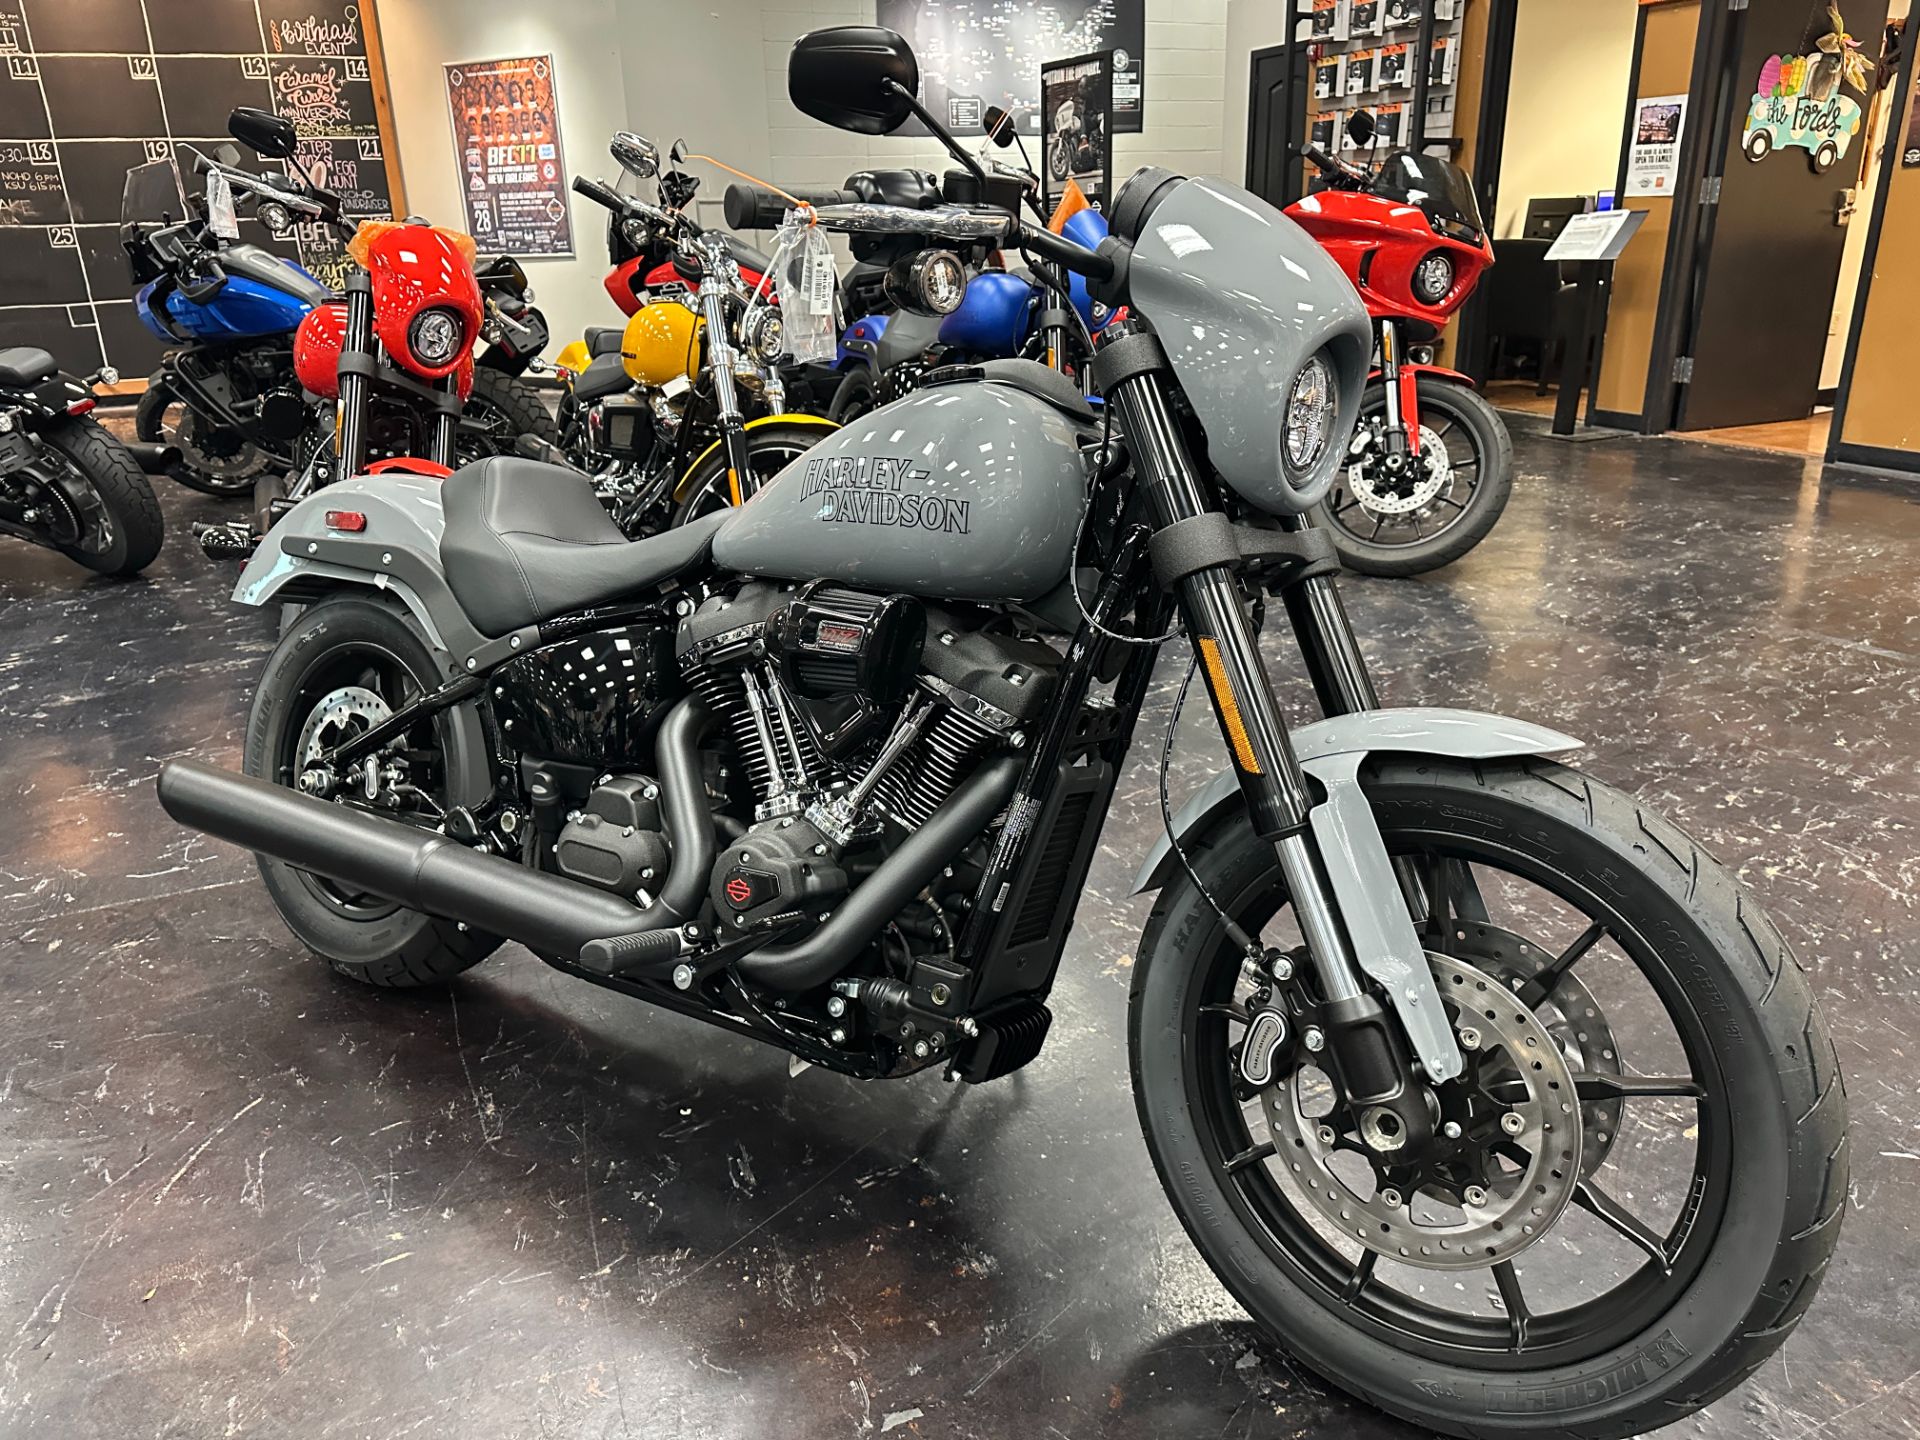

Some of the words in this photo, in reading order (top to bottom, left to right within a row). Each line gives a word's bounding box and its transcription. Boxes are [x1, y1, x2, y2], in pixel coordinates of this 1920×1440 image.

[281, 15, 353, 45] birthday
[305, 41, 346, 55] EVENT
[13, 58, 37, 76] 11
[132, 58, 155, 77] 12
[245, 57, 266, 76] 13
[349, 60, 368, 78] 14
[274, 67, 341, 93] Caramel
[279, 106, 351, 120] ANNIVERSARY
[1766, 96, 1788, 125] the
[1791, 96, 1842, 138] Fords
[31, 142, 52, 160] 18
[147, 141, 169, 161] 19
[361, 139, 381, 157] 21
[335, 160, 357, 176] EGG
[1635, 156, 1647, 164] OPEN
[1648, 155, 1654, 163] TO
[1655, 154, 1673, 163] FAMILY
[1, 171, 31, 181] NOHD
[328, 175, 358, 189] HUNT
[4, 181, 26, 190] KSU
[337, 189, 375, 199] NOHD
[475, 209, 491, 232] 28
[51, 227, 74, 245] 25
[302, 240, 340, 252] FIGHT
[799, 456, 931, 504] HARLEY-
[822, 490, 970, 534] DAVIDSON
